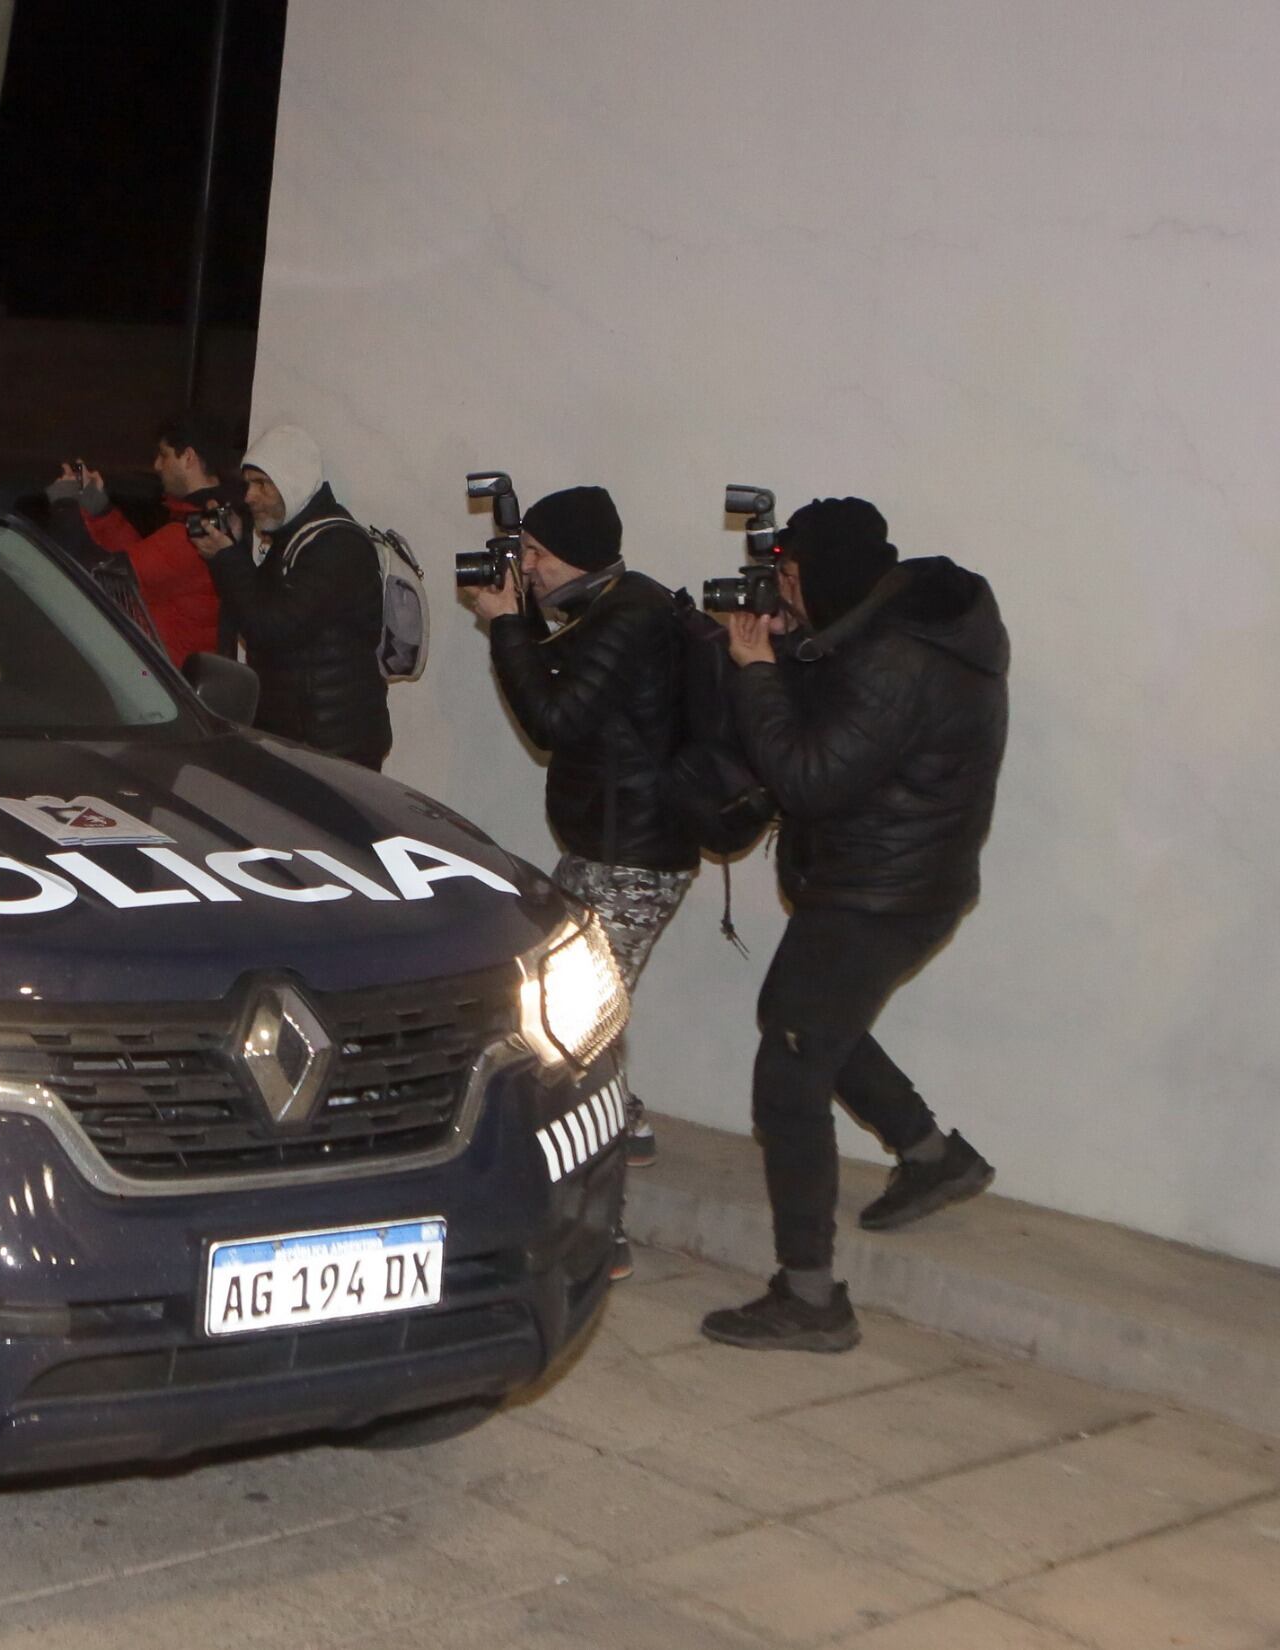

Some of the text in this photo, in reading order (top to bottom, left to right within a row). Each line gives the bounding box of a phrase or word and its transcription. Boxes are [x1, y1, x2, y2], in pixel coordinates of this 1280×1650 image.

[222, 1250, 431, 1323] AG 194 DX
